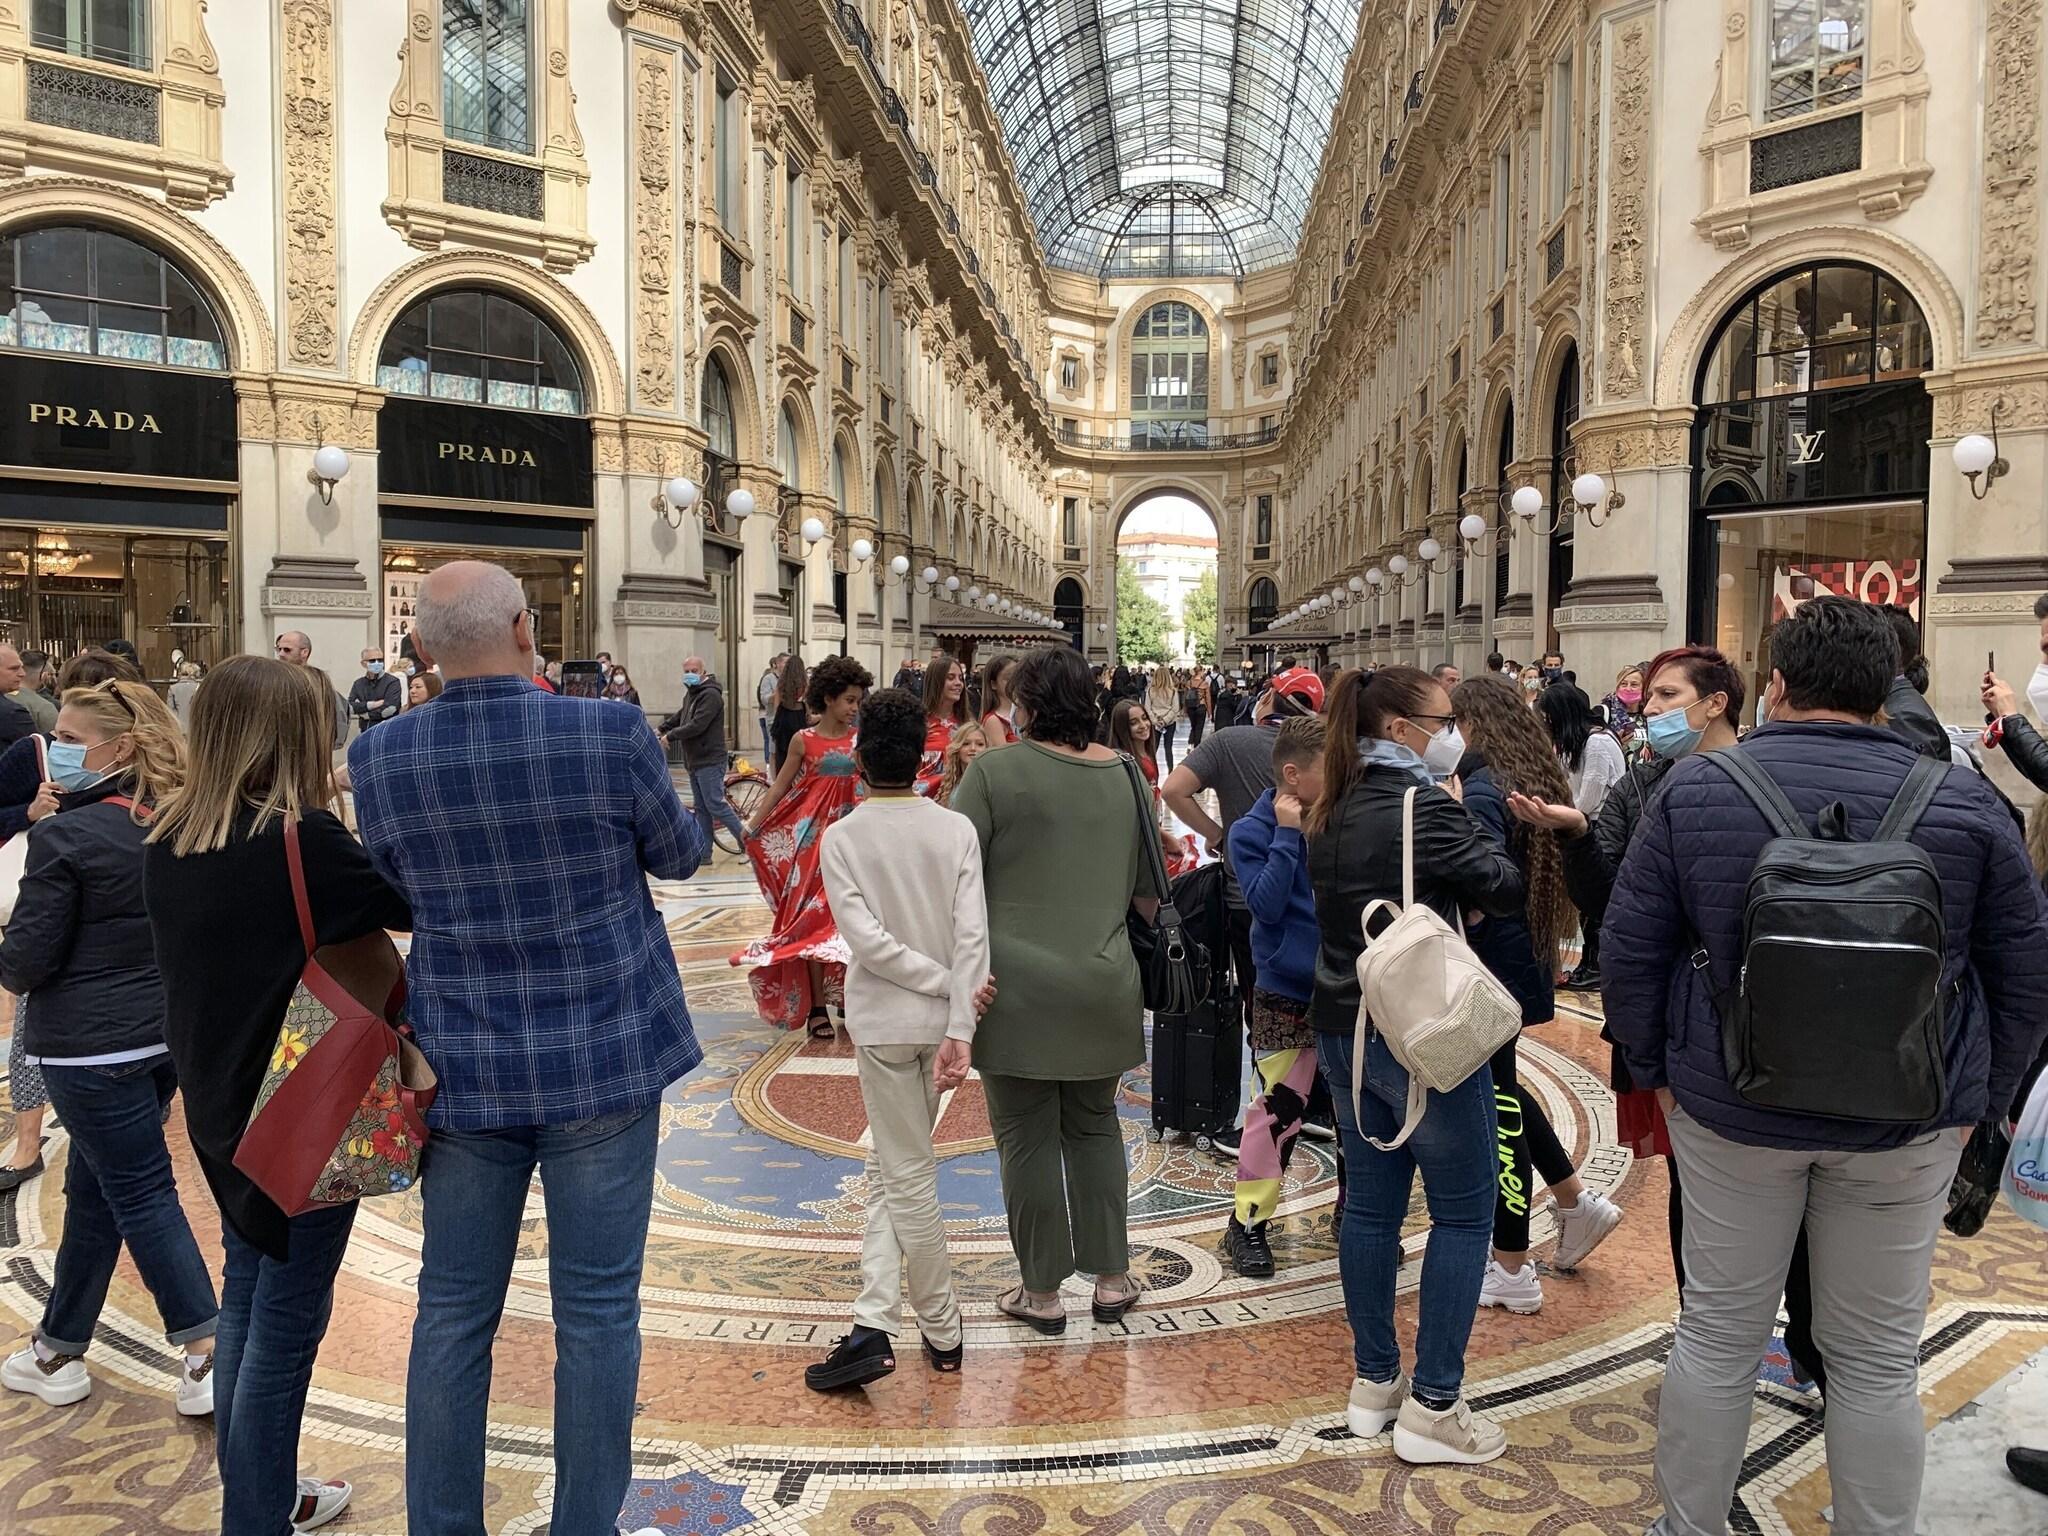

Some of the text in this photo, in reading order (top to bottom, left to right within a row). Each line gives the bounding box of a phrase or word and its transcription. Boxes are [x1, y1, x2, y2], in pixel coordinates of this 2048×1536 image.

[29, 403, 162, 434] PRADA
[438, 442, 537, 467] PRADA
[1562, 1075, 1613, 1104] FERT
[1581, 1148, 1628, 1187] FERT
[695, 1318, 834, 1346] ERT
[1110, 1302, 1261, 1337] FERT
